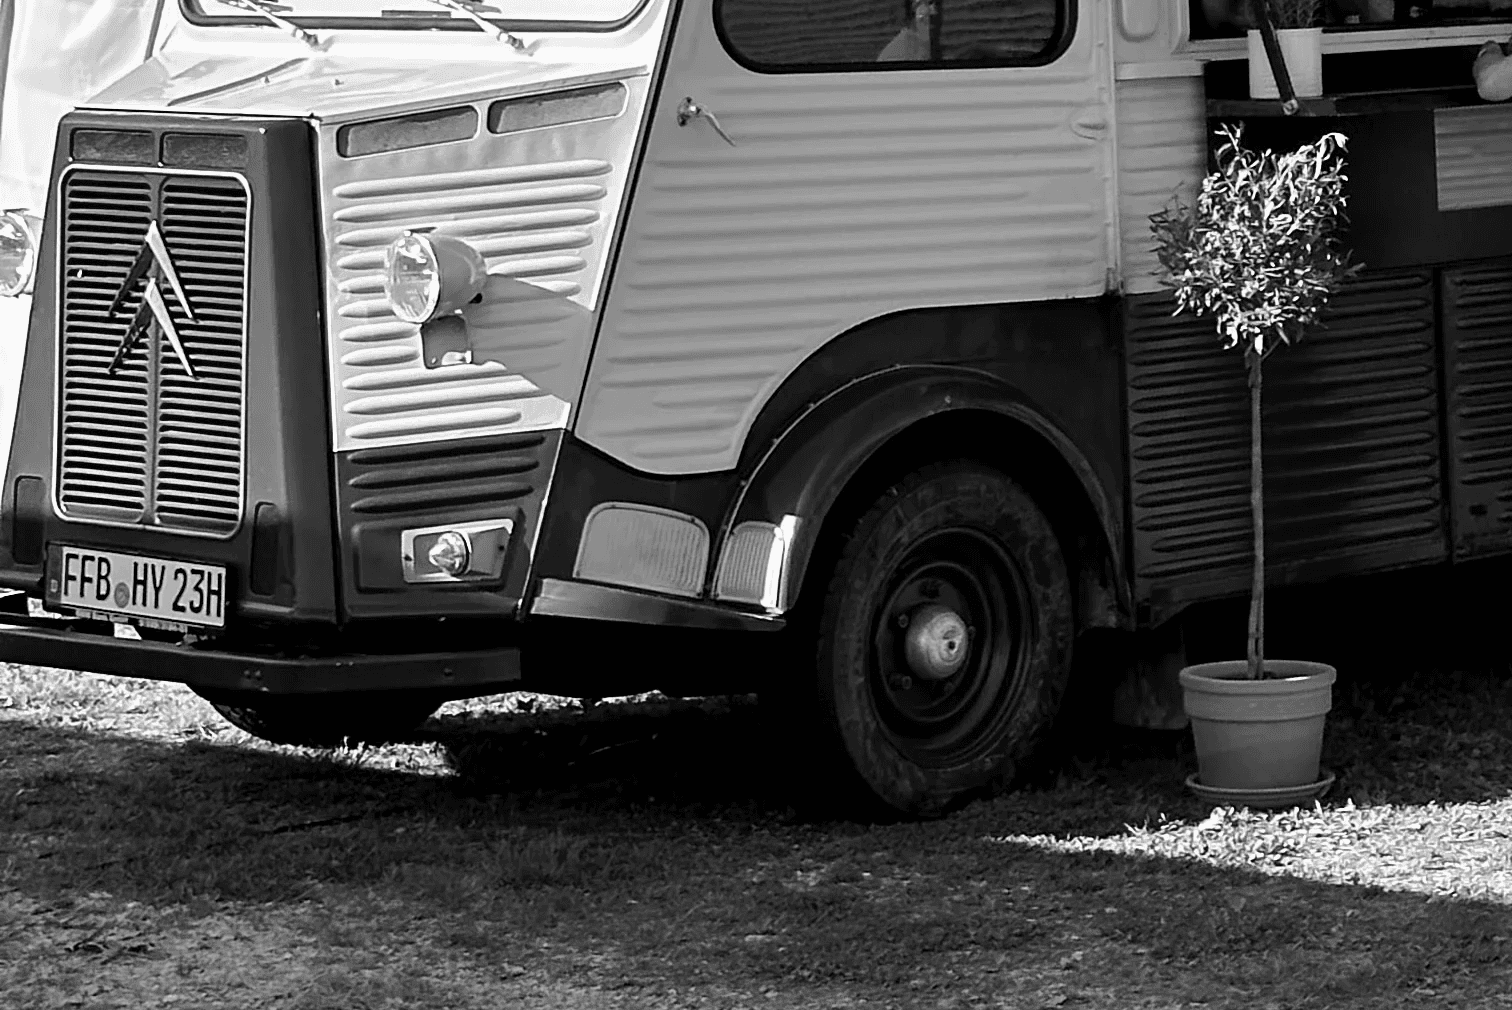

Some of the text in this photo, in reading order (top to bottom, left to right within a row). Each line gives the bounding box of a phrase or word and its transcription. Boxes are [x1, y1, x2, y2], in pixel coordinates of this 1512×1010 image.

[63, 552, 223, 618] FFB HY 23H
